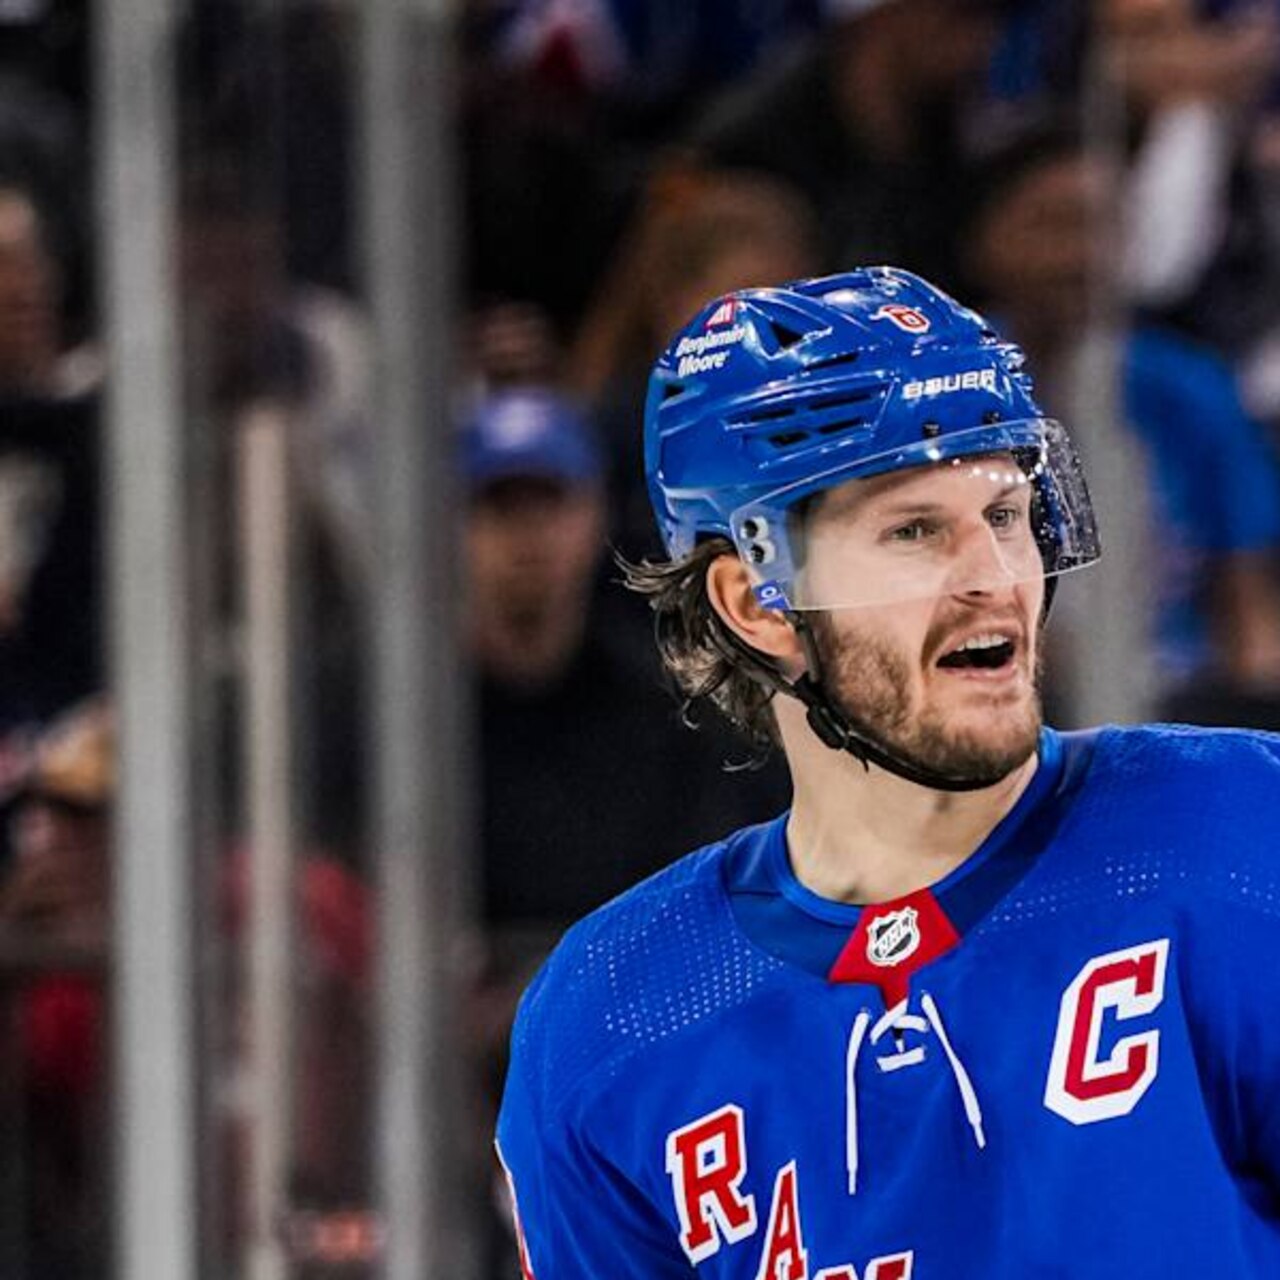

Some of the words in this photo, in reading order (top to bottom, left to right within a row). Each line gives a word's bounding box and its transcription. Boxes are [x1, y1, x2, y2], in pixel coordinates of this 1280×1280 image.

[675, 324, 746, 356] Benjamin
[678, 350, 730, 377] Moore
[1044, 938, 1169, 1125] C
